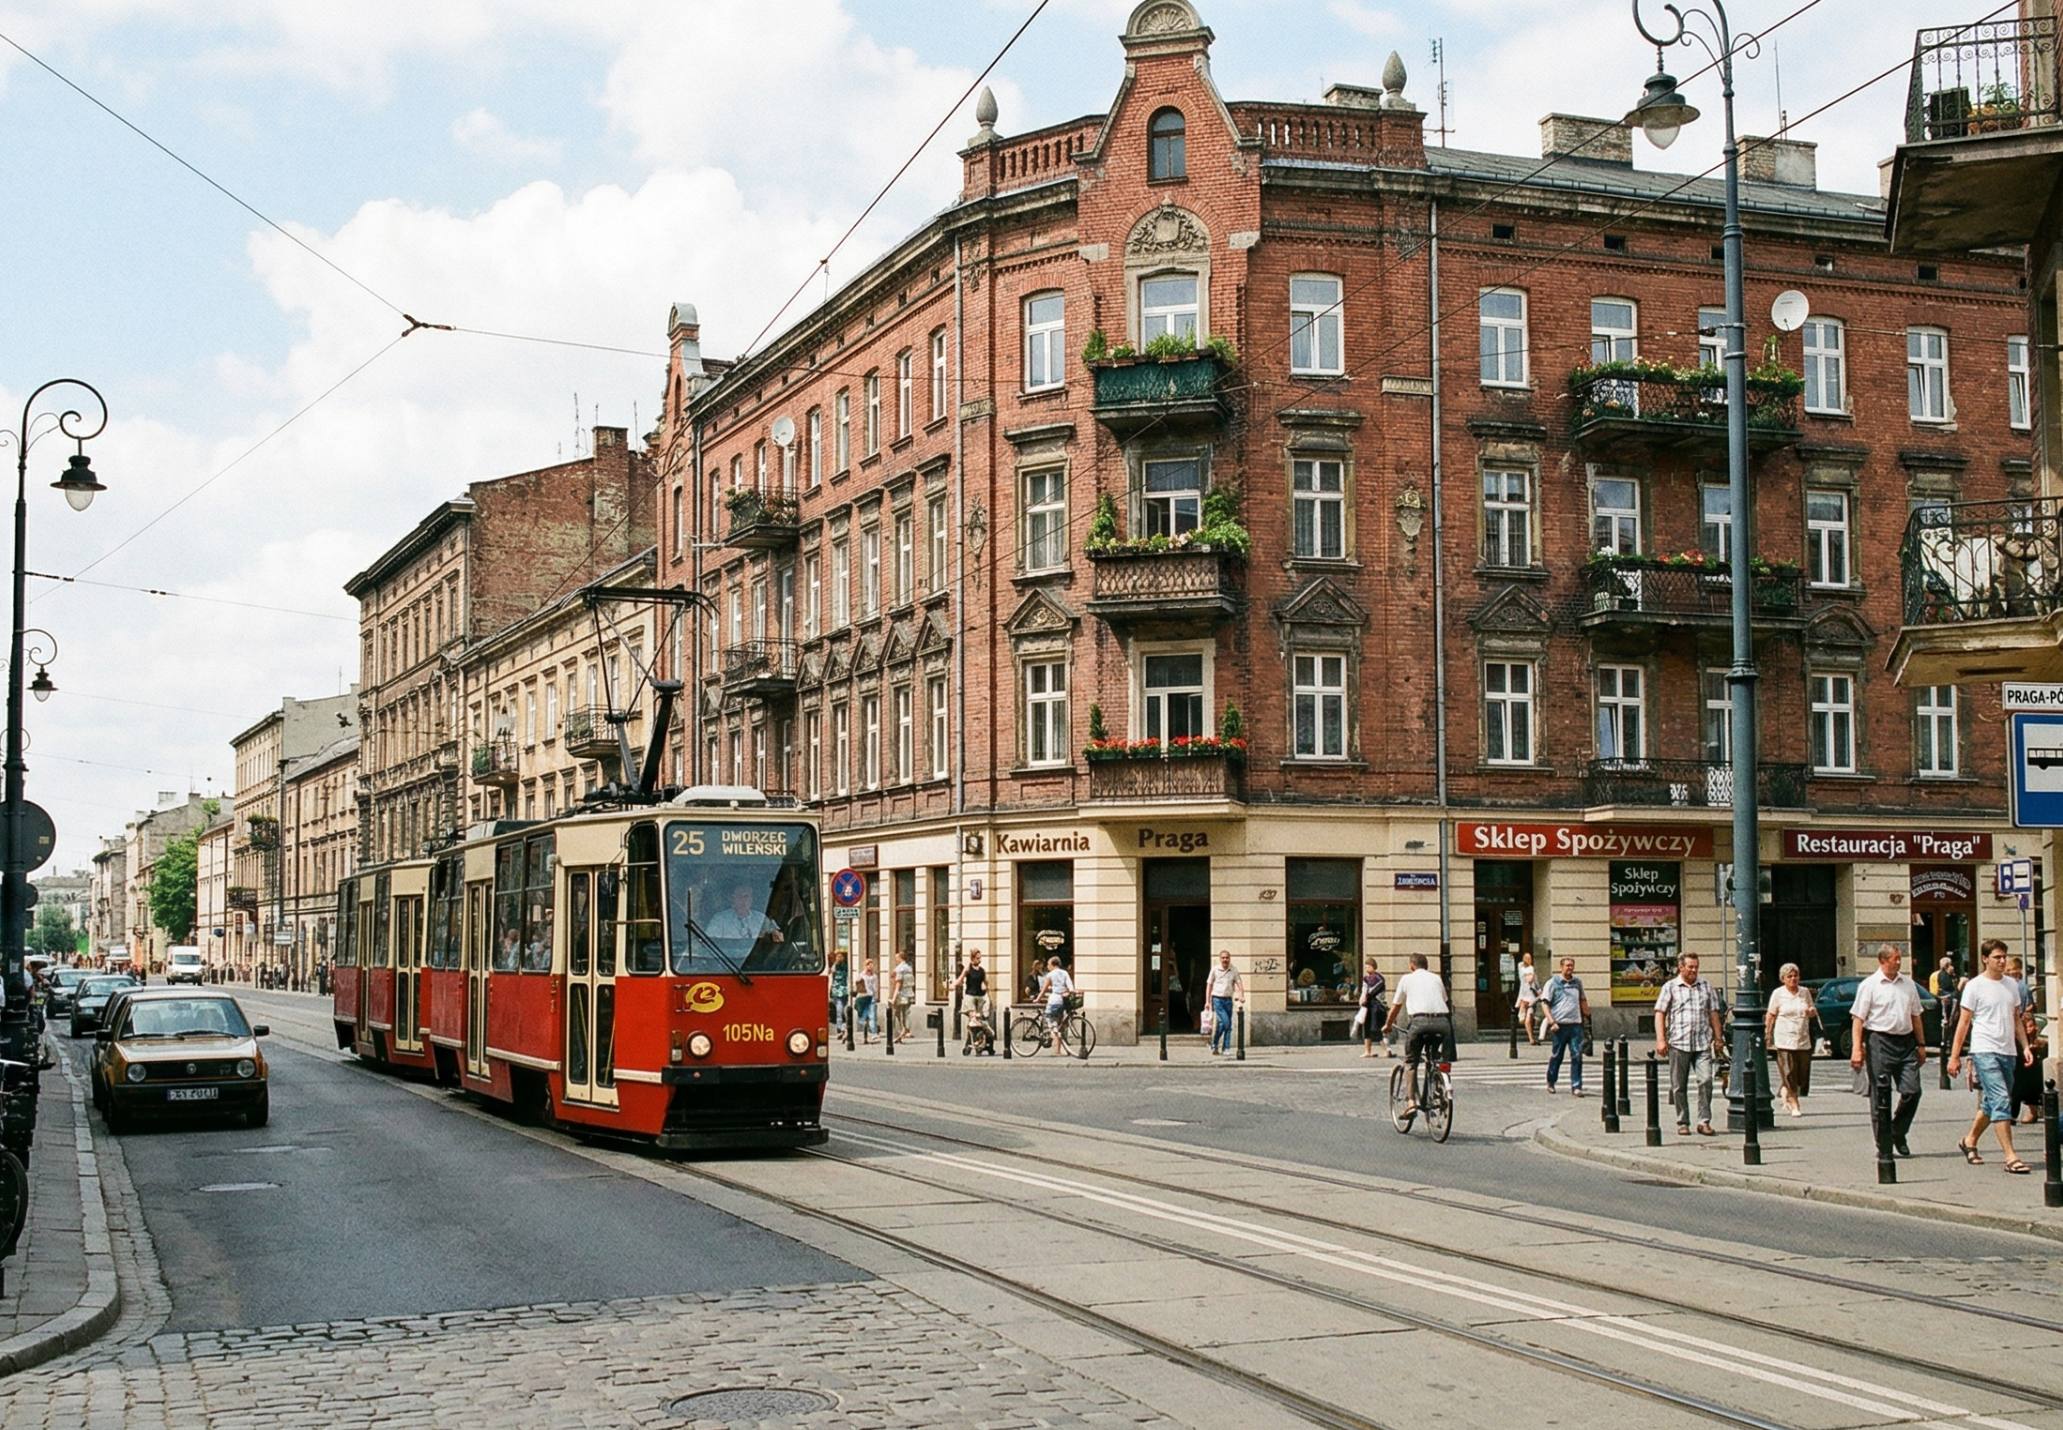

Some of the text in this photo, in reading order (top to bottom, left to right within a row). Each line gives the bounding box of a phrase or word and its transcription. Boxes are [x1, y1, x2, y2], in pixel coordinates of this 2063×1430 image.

[672, 830, 705, 855] 25
[996, 831, 1090, 854] Kawiarnia
[1138, 828, 1209, 853] Praga
[1474, 826, 1696, 857] Sklep Spożywczy
[1797, 834, 1906, 859] Restauracja
[1624, 867, 1659, 883] Sklep
[722, 1023, 775, 1042] 105Na
